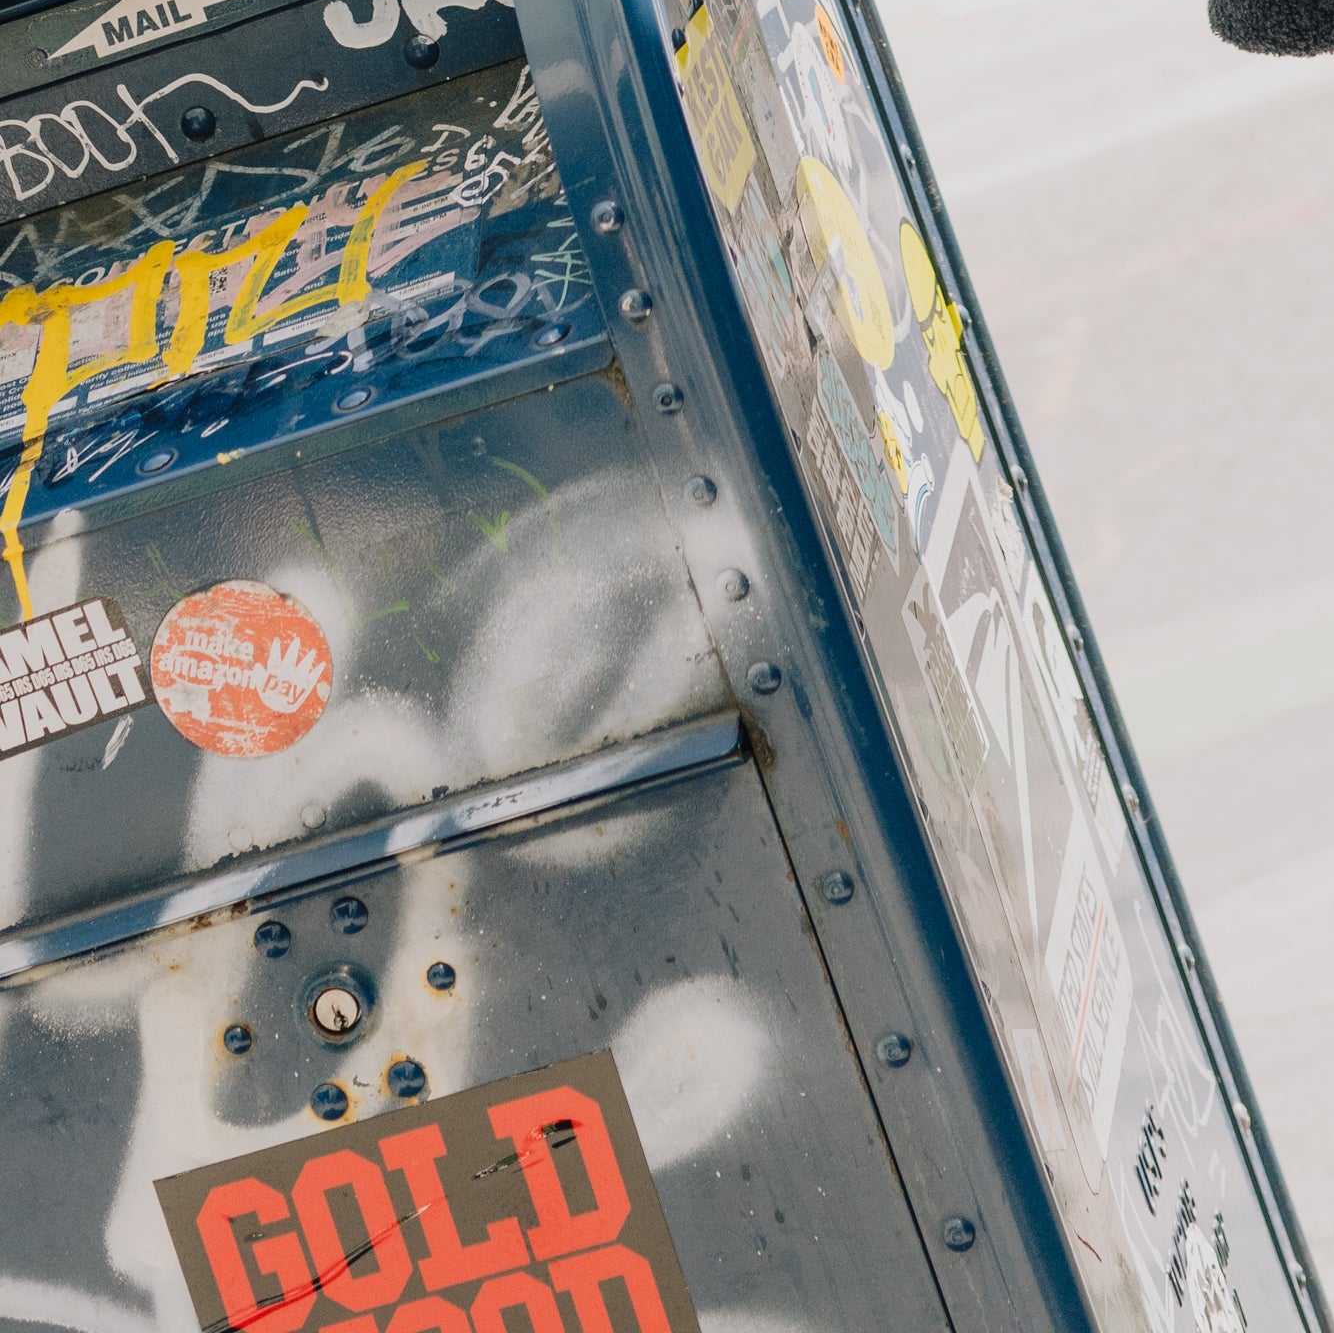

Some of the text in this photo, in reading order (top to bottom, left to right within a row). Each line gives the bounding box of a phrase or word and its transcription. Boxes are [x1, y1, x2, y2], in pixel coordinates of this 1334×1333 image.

[101, 0, 193, 46] MAIL
[12, 675, 34, 697] IRS
[30, 667, 57, 692] D65
[52, 660, 75, 681] IRS
[71, 653, 97, 676] D65
[93, 646, 116, 668] IRS
[111, 637, 137, 662] D65
[185, 624, 254, 664] make
[262, 672, 307, 706] pay
[196, 1084, 632, 1333] GOLD
